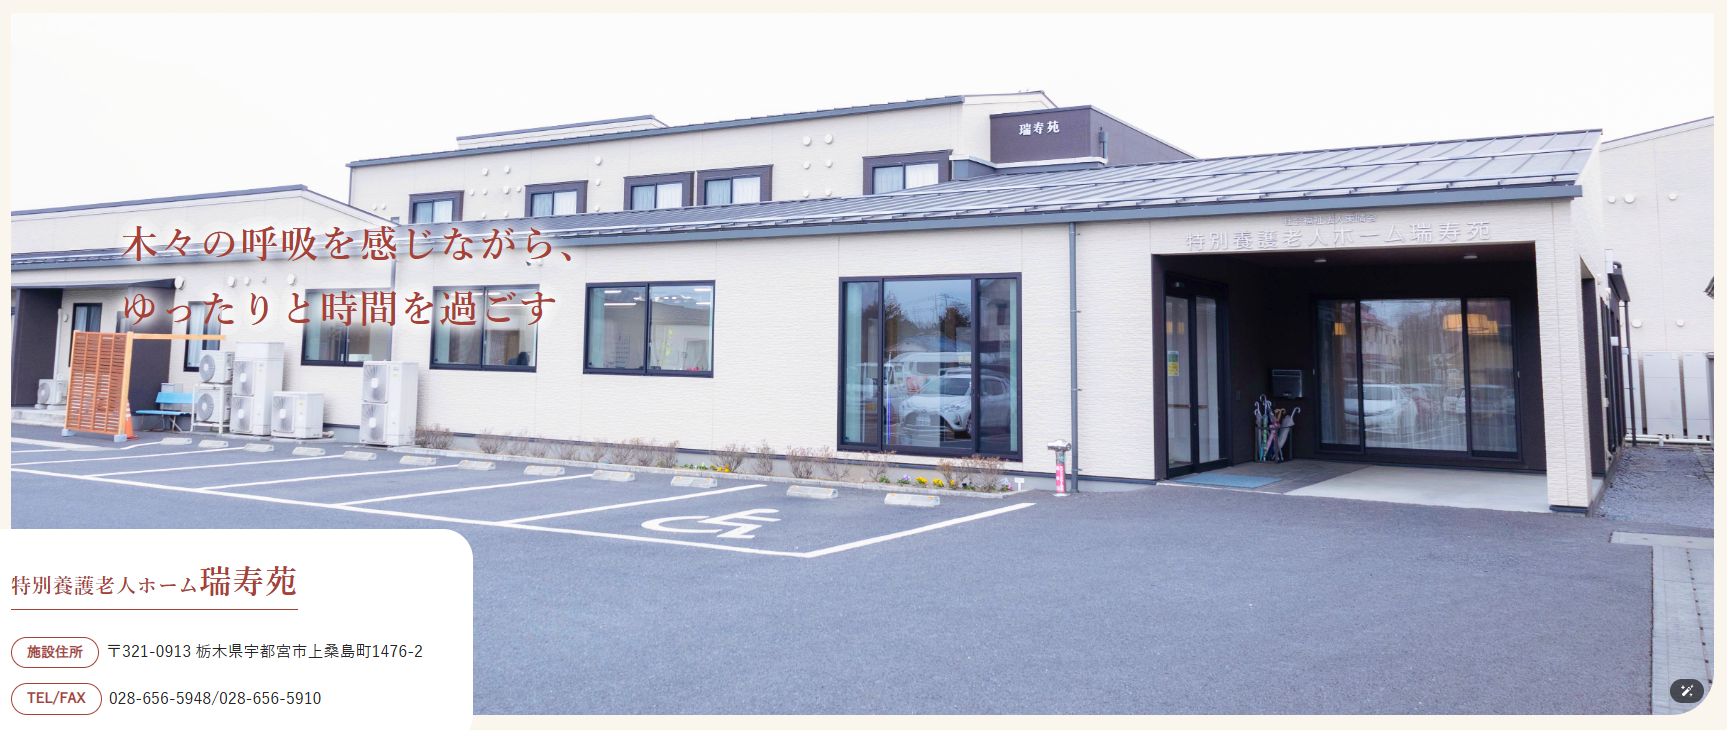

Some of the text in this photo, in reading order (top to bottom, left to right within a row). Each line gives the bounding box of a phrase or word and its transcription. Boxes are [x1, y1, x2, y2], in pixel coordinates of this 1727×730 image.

[1019, 120, 1060, 136] 瑞寿苑
[1185, 220, 1491, 251] 特別養護老人ホーム瑞寿苑
